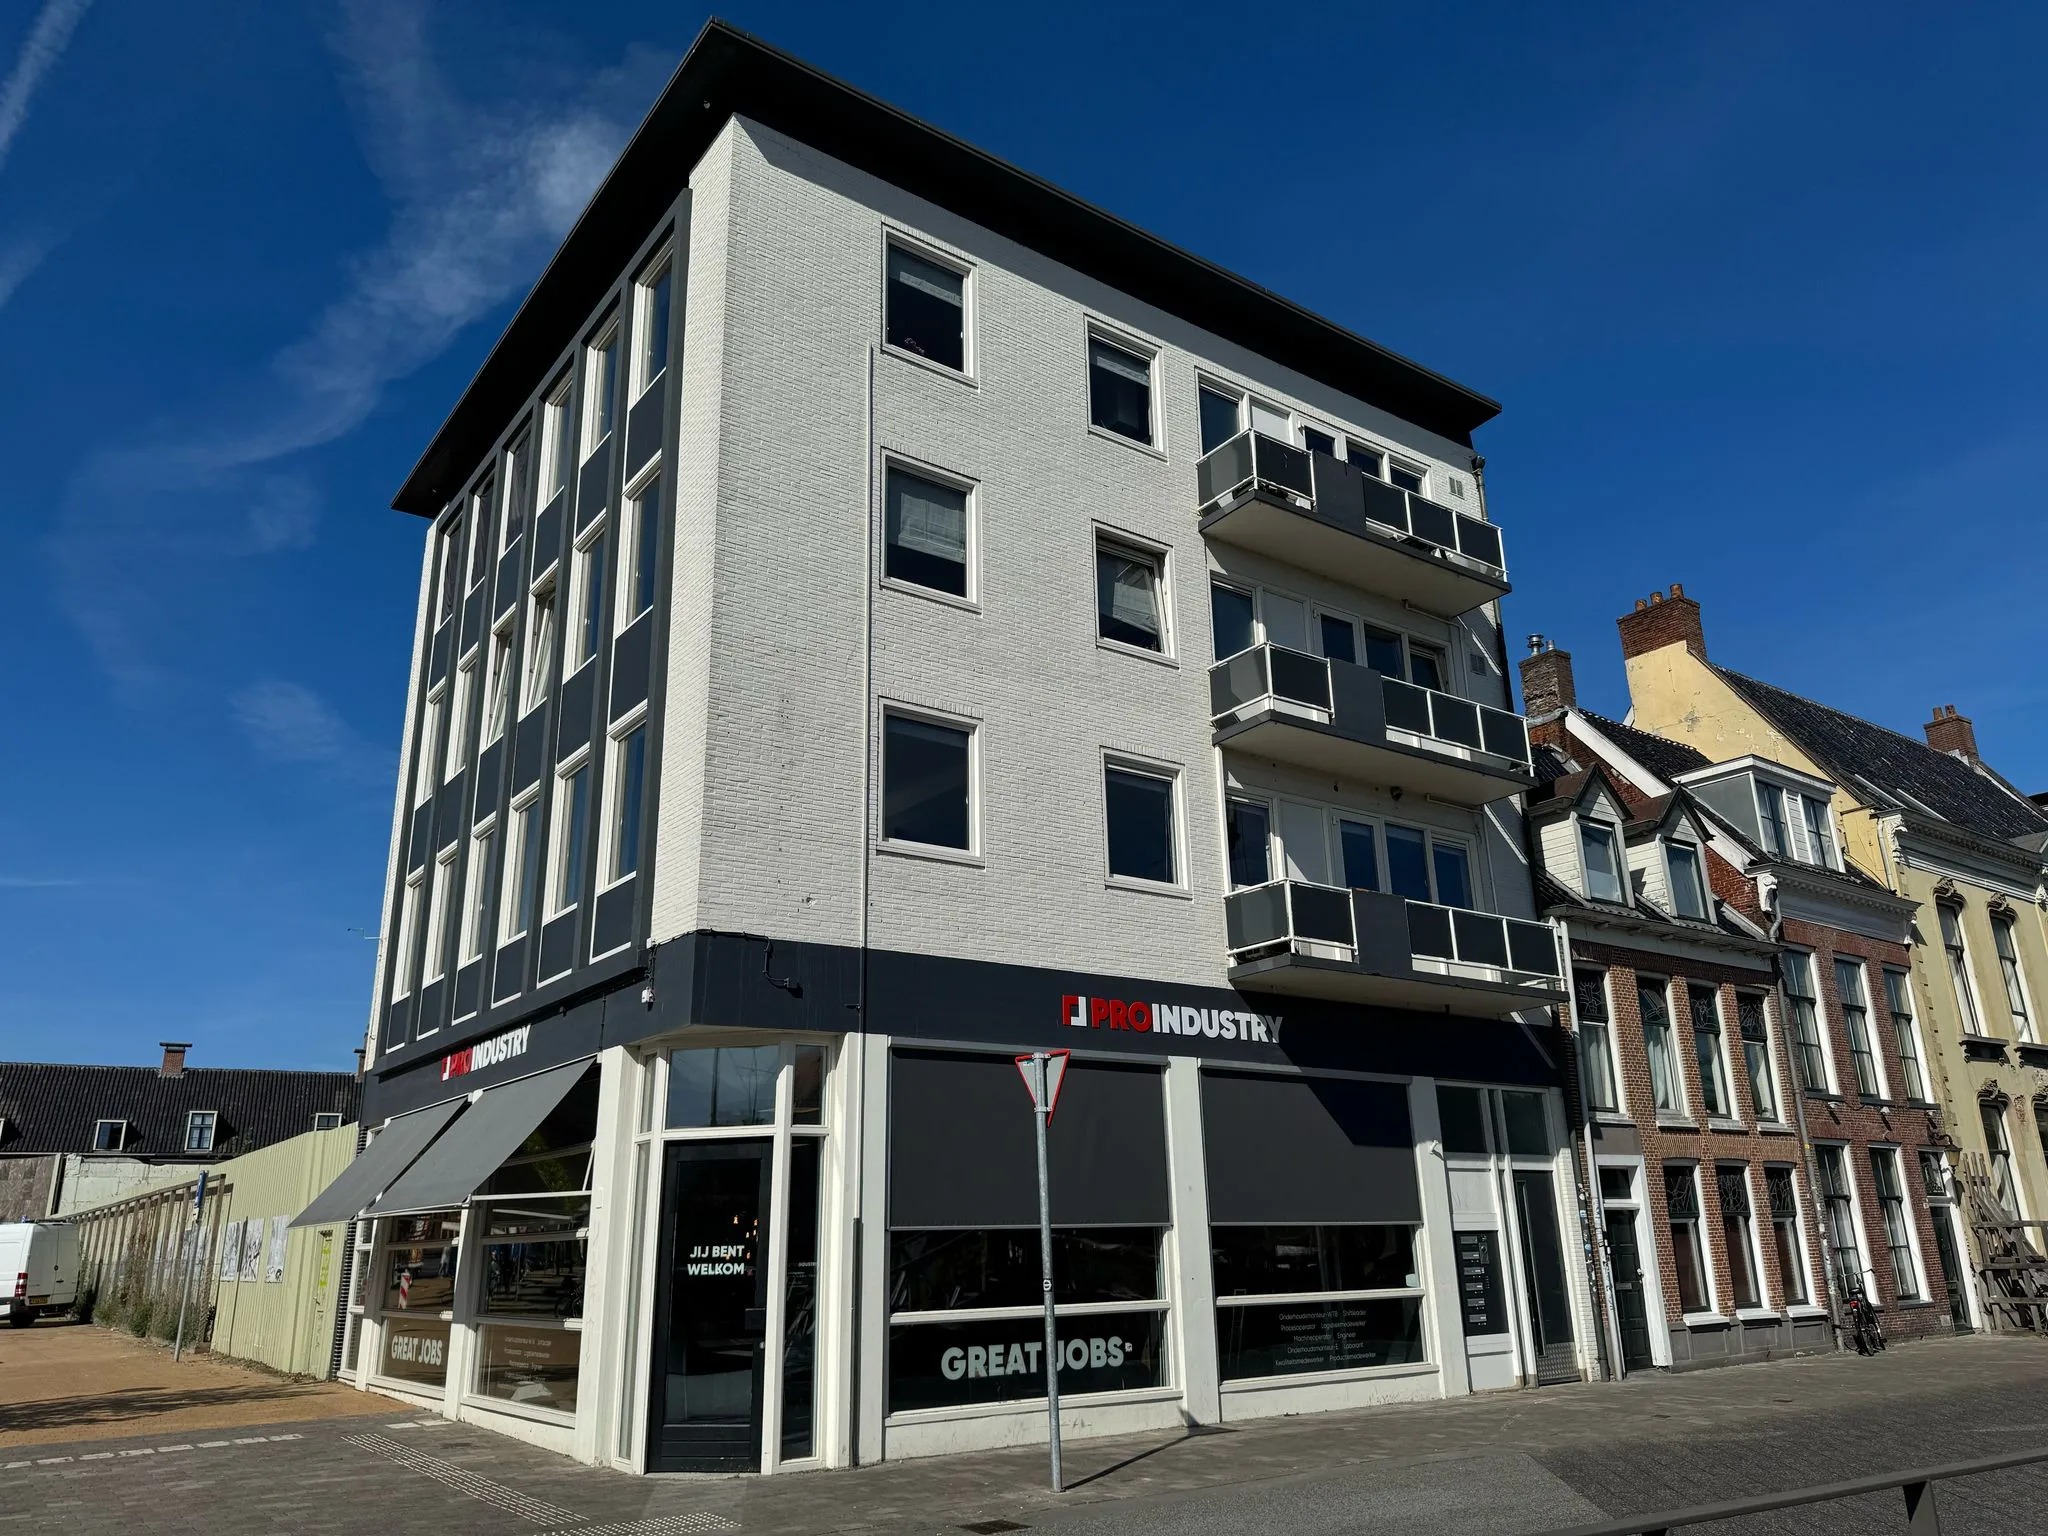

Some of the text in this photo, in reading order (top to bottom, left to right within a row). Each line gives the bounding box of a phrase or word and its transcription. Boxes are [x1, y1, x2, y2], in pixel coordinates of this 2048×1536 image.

[1091, 997, 1283, 1043] PROINDUSTRY
[690, 1245, 745, 1258] JIJ BENT
[687, 1263, 745, 1275] WELKOM
[392, 1335, 443, 1366] GREAT JOBS
[941, 1341, 1042, 1380] GREAT
